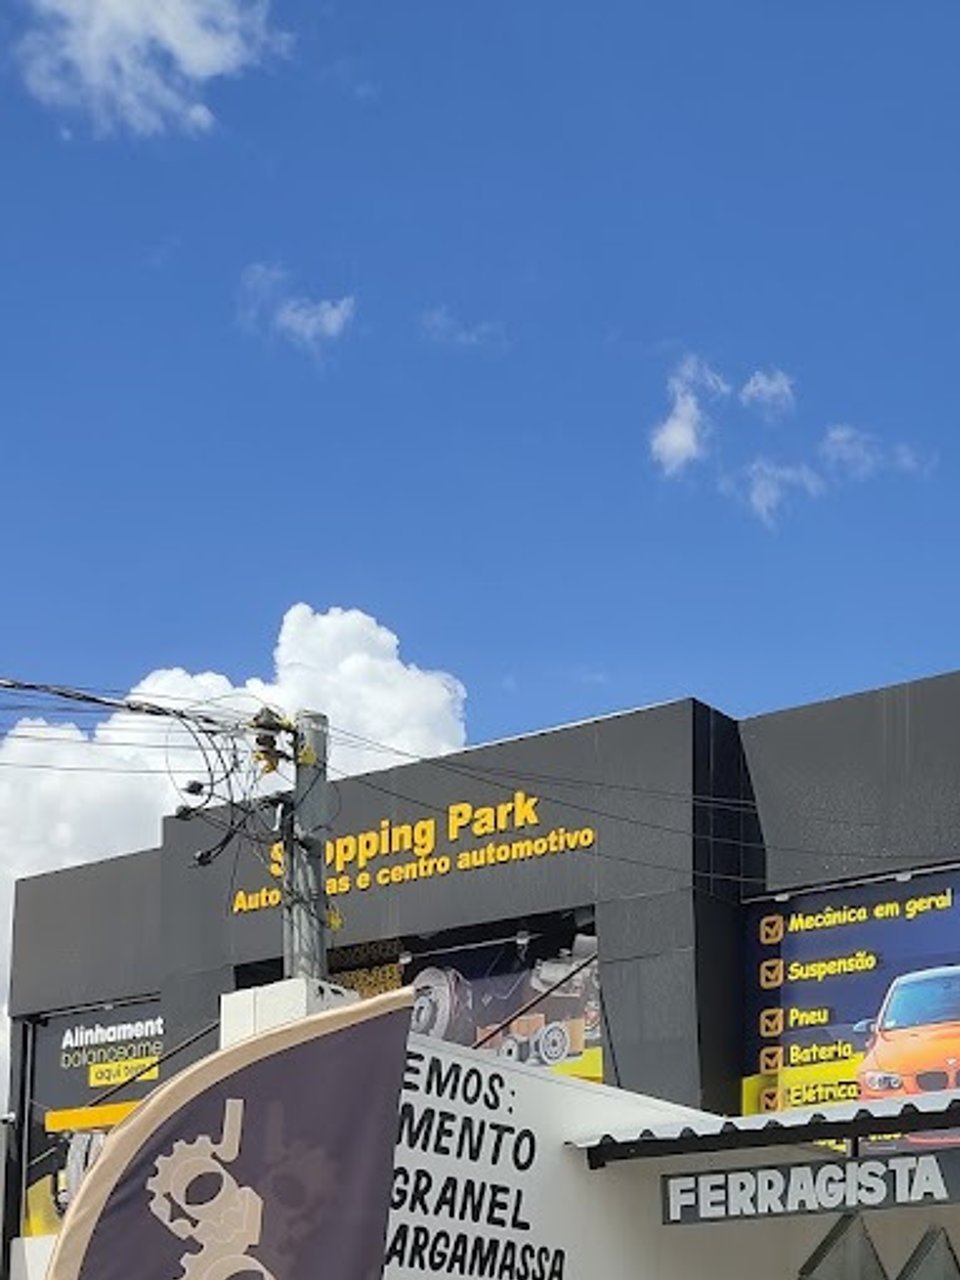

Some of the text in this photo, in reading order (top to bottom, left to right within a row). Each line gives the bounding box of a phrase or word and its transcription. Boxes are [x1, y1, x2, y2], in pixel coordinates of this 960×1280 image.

[269, 790, 540, 877] Spping Park
[232, 886, 282, 914] Auto
[376, 855, 451, 885] centro
[456, 827, 595, 870] automotivo
[788, 888, 952, 932] Mecânica em geral
[787, 951, 877, 982] Suspensão
[788, 1007, 829, 1028] Pneu
[789, 1039, 853, 1064] Bateria
[398, 1102, 536, 1171] MENTO
[390, 1166, 531, 1231] GRANEL
[667, 1154, 949, 1221] FERRAGISTA
